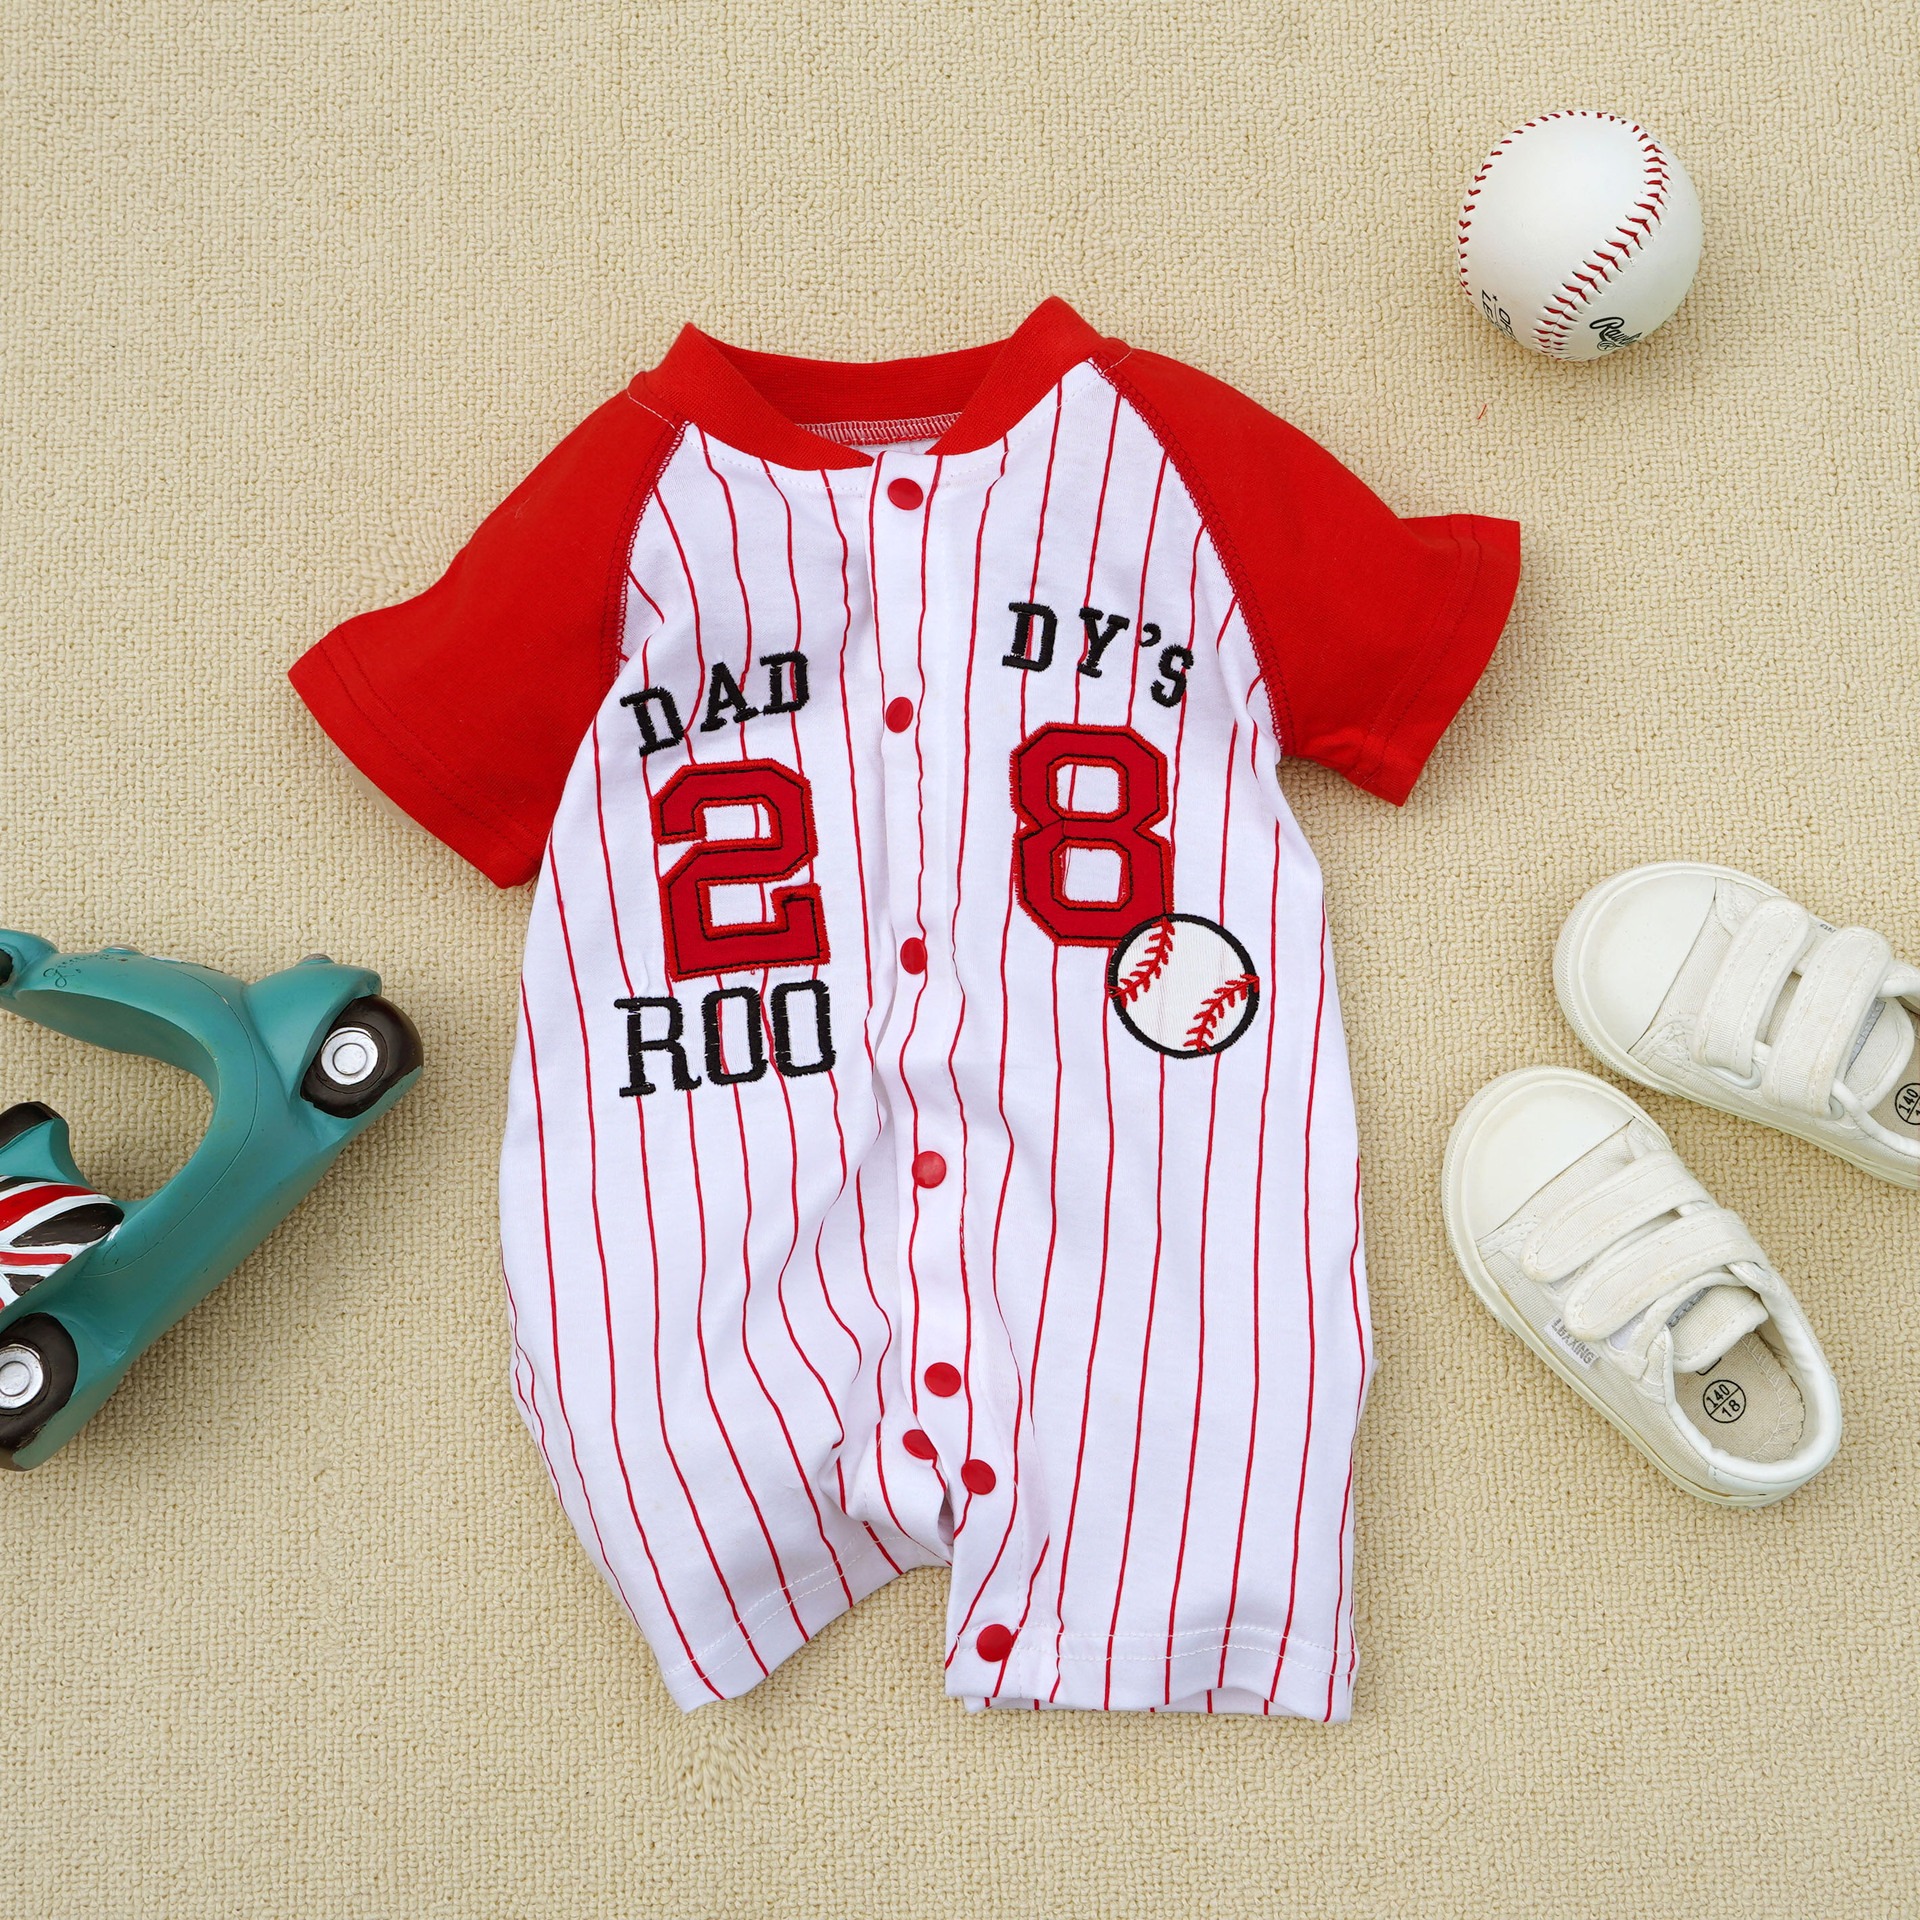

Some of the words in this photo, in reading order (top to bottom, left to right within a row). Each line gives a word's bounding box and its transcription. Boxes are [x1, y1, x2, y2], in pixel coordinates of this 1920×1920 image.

[620, 650, 810, 756] DAD
[1002, 602, 1194, 707] DY'S
[650, 757, 831, 982] 2
[1009, 722, 1174, 948] 8
[614, 979, 836, 1097] ROO
[1899, 1088, 1919, 1113] 140
[1706, 1384, 1730, 1408] 140
[1721, 1400, 1741, 1417] 18
